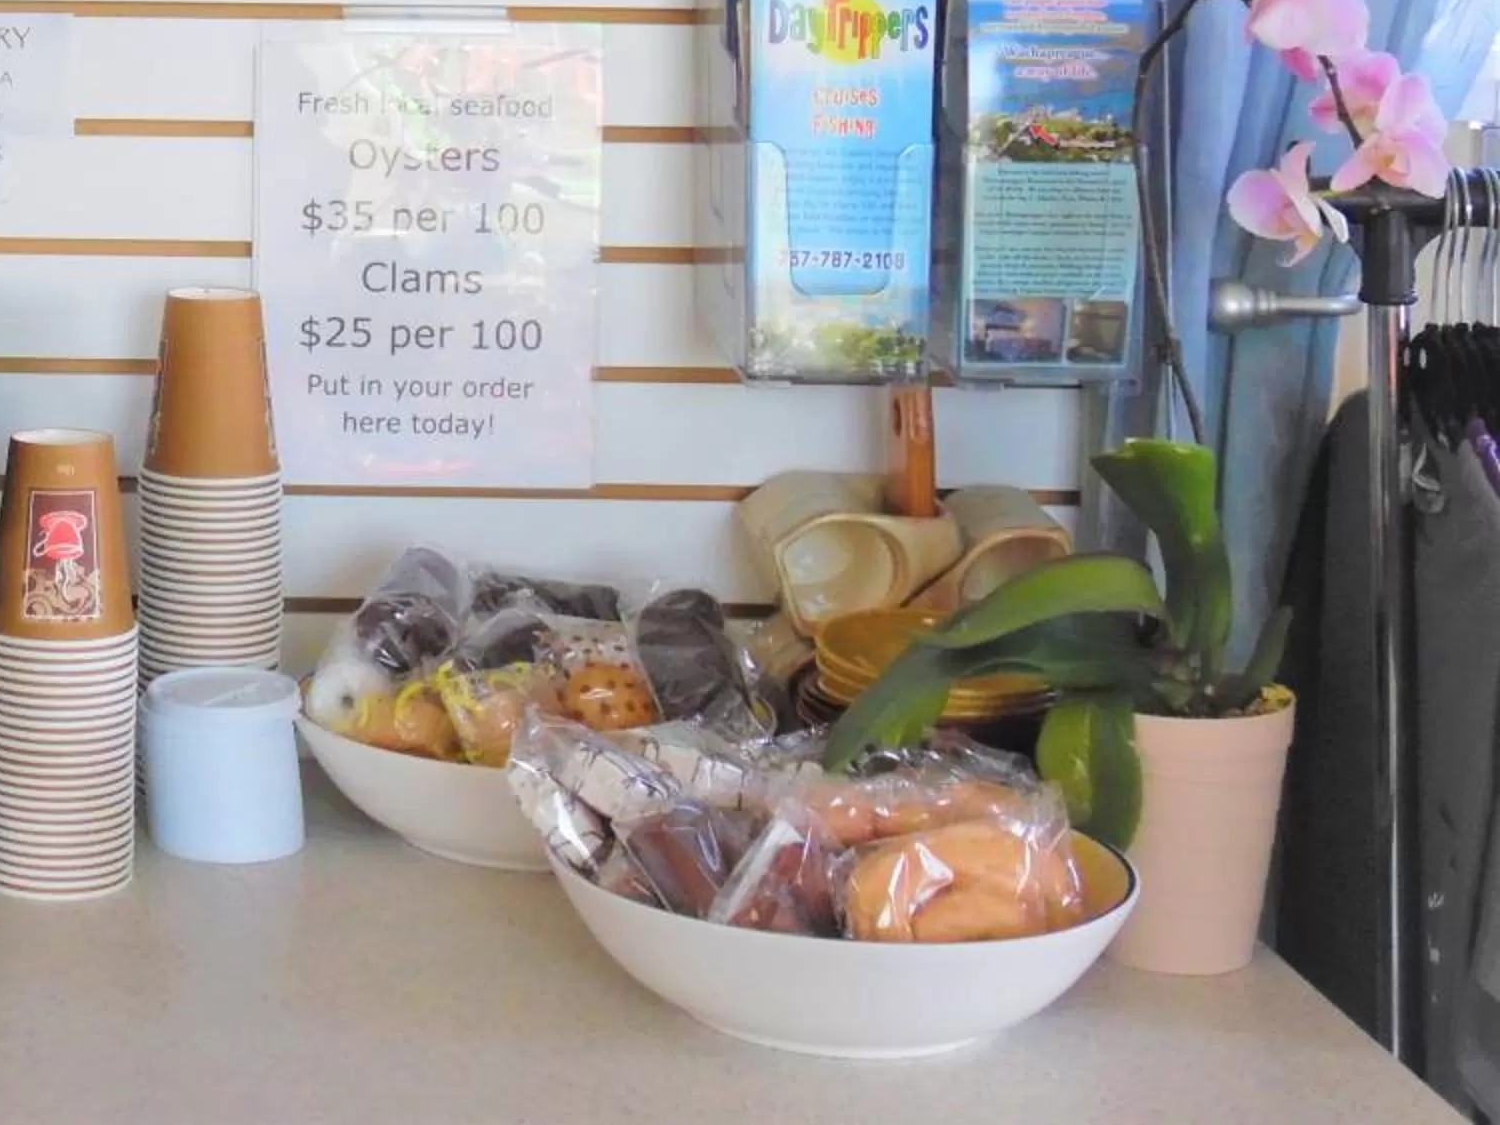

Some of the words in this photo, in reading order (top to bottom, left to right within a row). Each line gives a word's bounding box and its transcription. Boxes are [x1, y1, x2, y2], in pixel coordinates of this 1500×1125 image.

[298, 91, 369, 117] Fresh
[449, 93, 553, 118] seafood
[349, 139, 501, 177] Oysters
[301, 195, 374, 237] $35
[393, 205, 456, 239] per
[474, 202, 546, 236] 100
[361, 260, 484, 295] Clams
[299, 315, 373, 354] $25
[390, 321, 455, 356] per
[471, 319, 543, 351] 100
[307, 374, 350, 397] Put
[359, 374, 381, 397] in
[392, 378, 454, 404] your
[462, 375, 535, 400] order
[342, 411, 402, 435] here
[411, 412, 496, 440] today!
